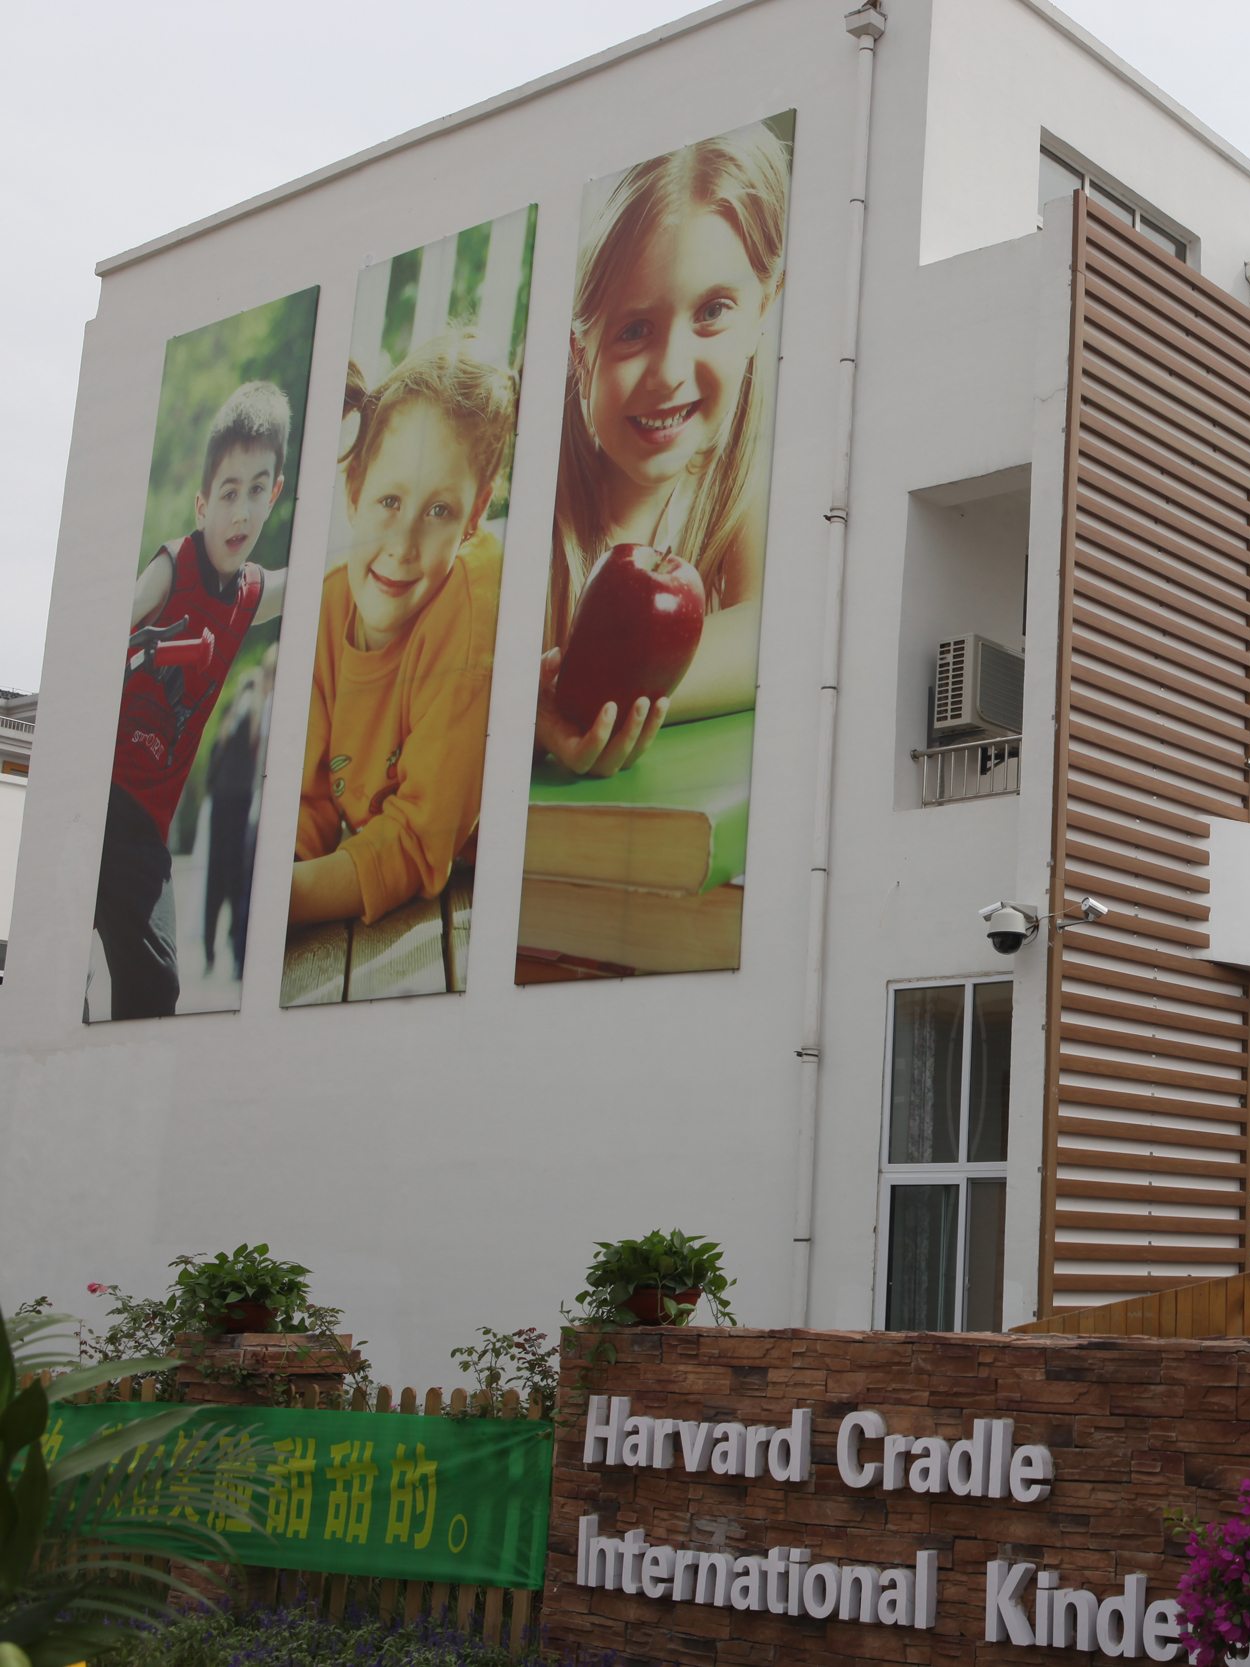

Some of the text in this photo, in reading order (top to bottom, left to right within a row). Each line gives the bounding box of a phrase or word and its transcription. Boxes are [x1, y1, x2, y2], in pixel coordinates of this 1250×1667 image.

[583, 1395, 1054, 1503] Harvard Cradle
[576, 1513, 938, 1630] International
